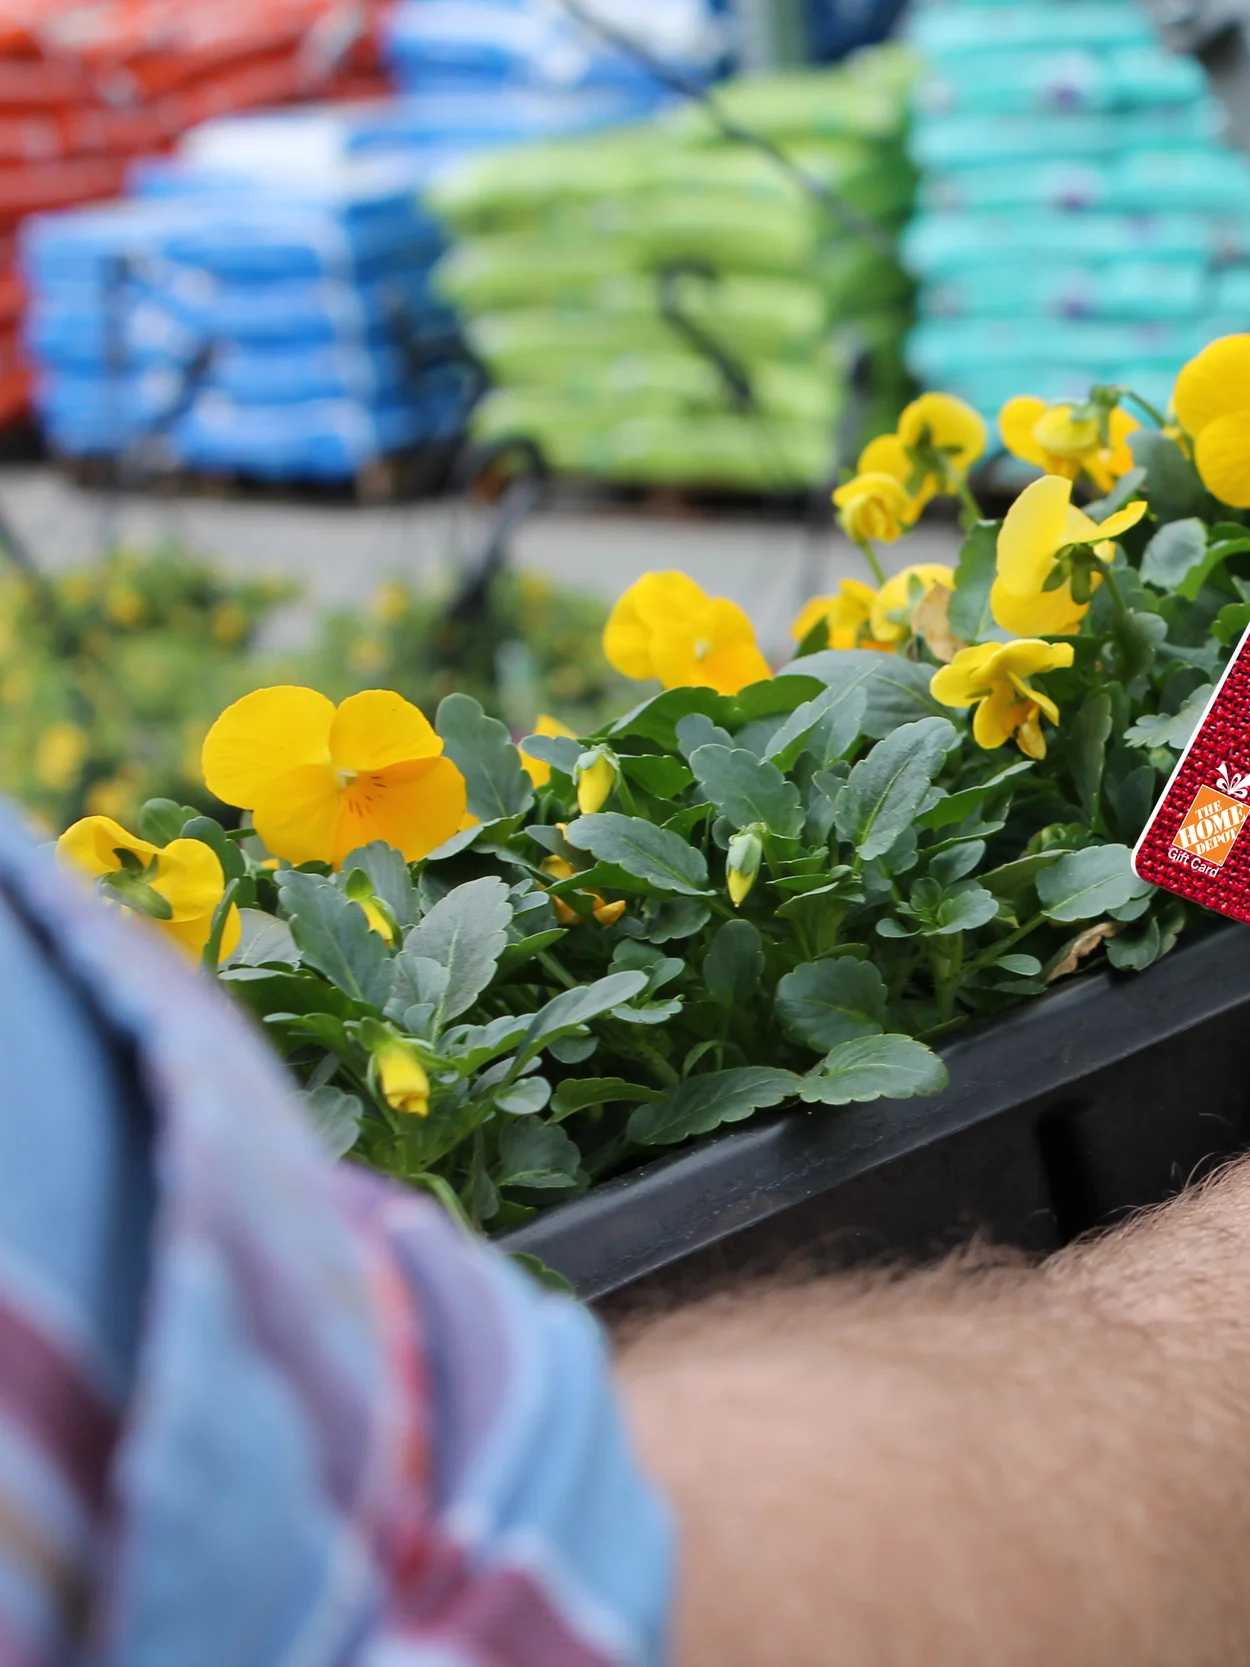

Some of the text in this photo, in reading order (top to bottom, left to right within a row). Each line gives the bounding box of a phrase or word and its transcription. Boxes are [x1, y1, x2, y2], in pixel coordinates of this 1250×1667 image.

[1194, 800, 1222, 820] THE
[1179, 803, 1246, 848] HOME
[1195, 827, 1238, 855] DEPOT
[1168, 848, 1219, 878] Gift Card
